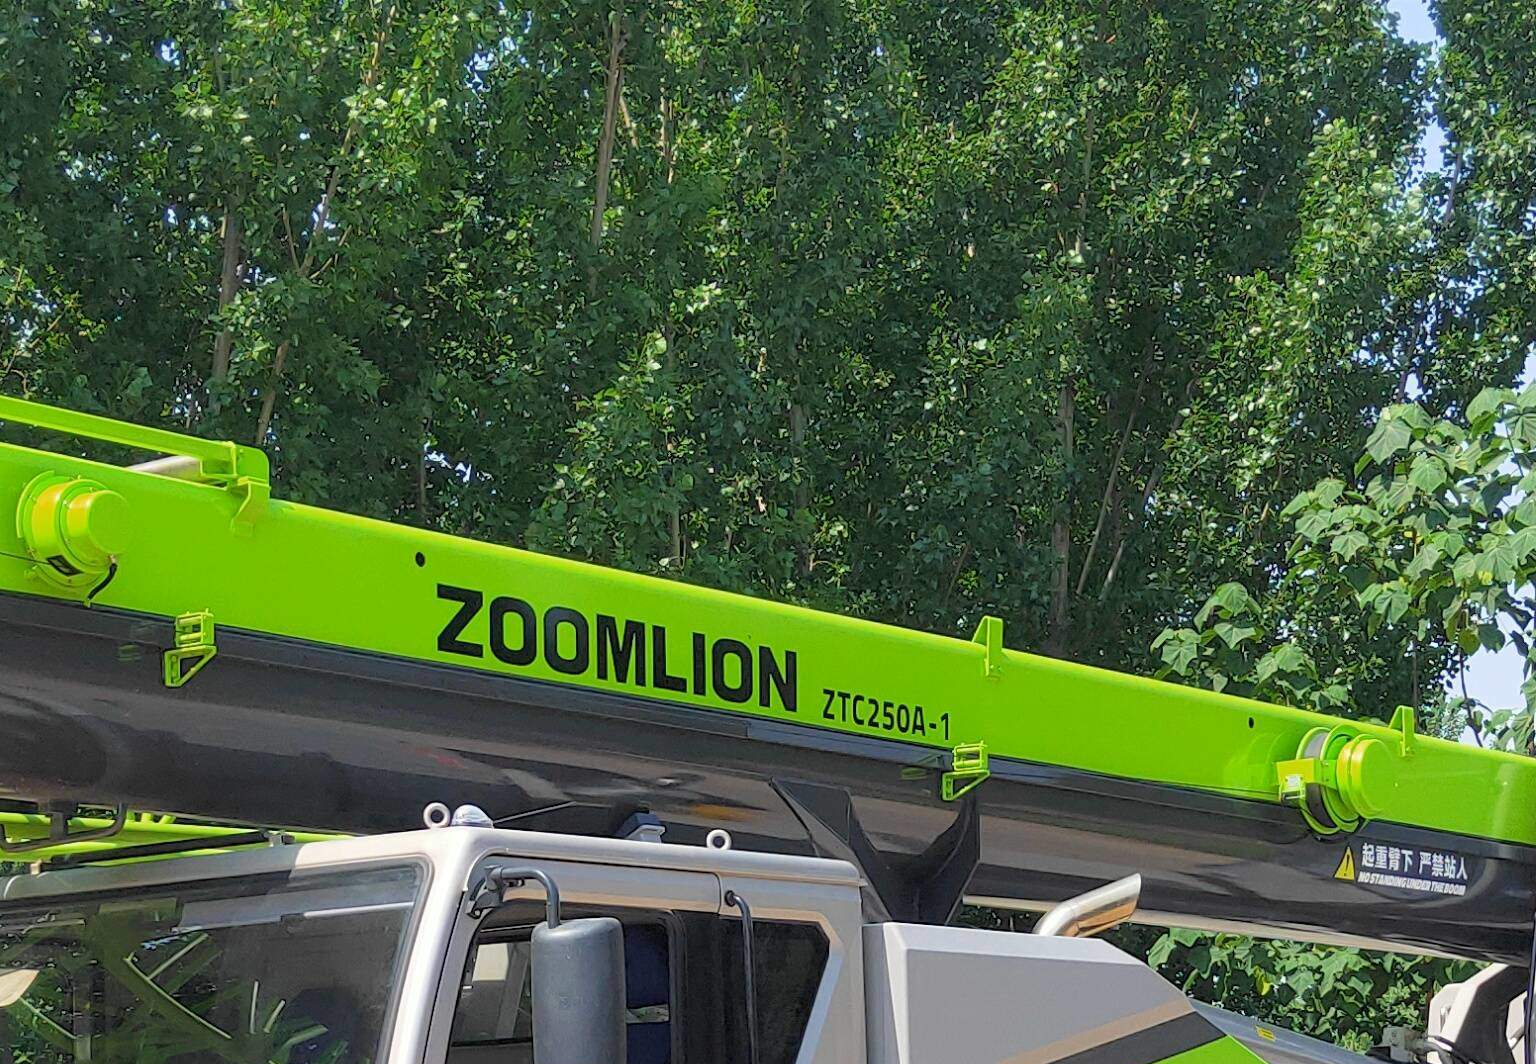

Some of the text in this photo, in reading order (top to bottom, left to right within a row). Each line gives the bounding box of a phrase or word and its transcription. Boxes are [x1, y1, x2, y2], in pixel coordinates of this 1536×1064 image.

[436, 583, 798, 713] ZOOMLION
[821, 689, 952, 741] ZTC250A-1
[1361, 842, 1469, 880] 起重臂下 严禁站人
